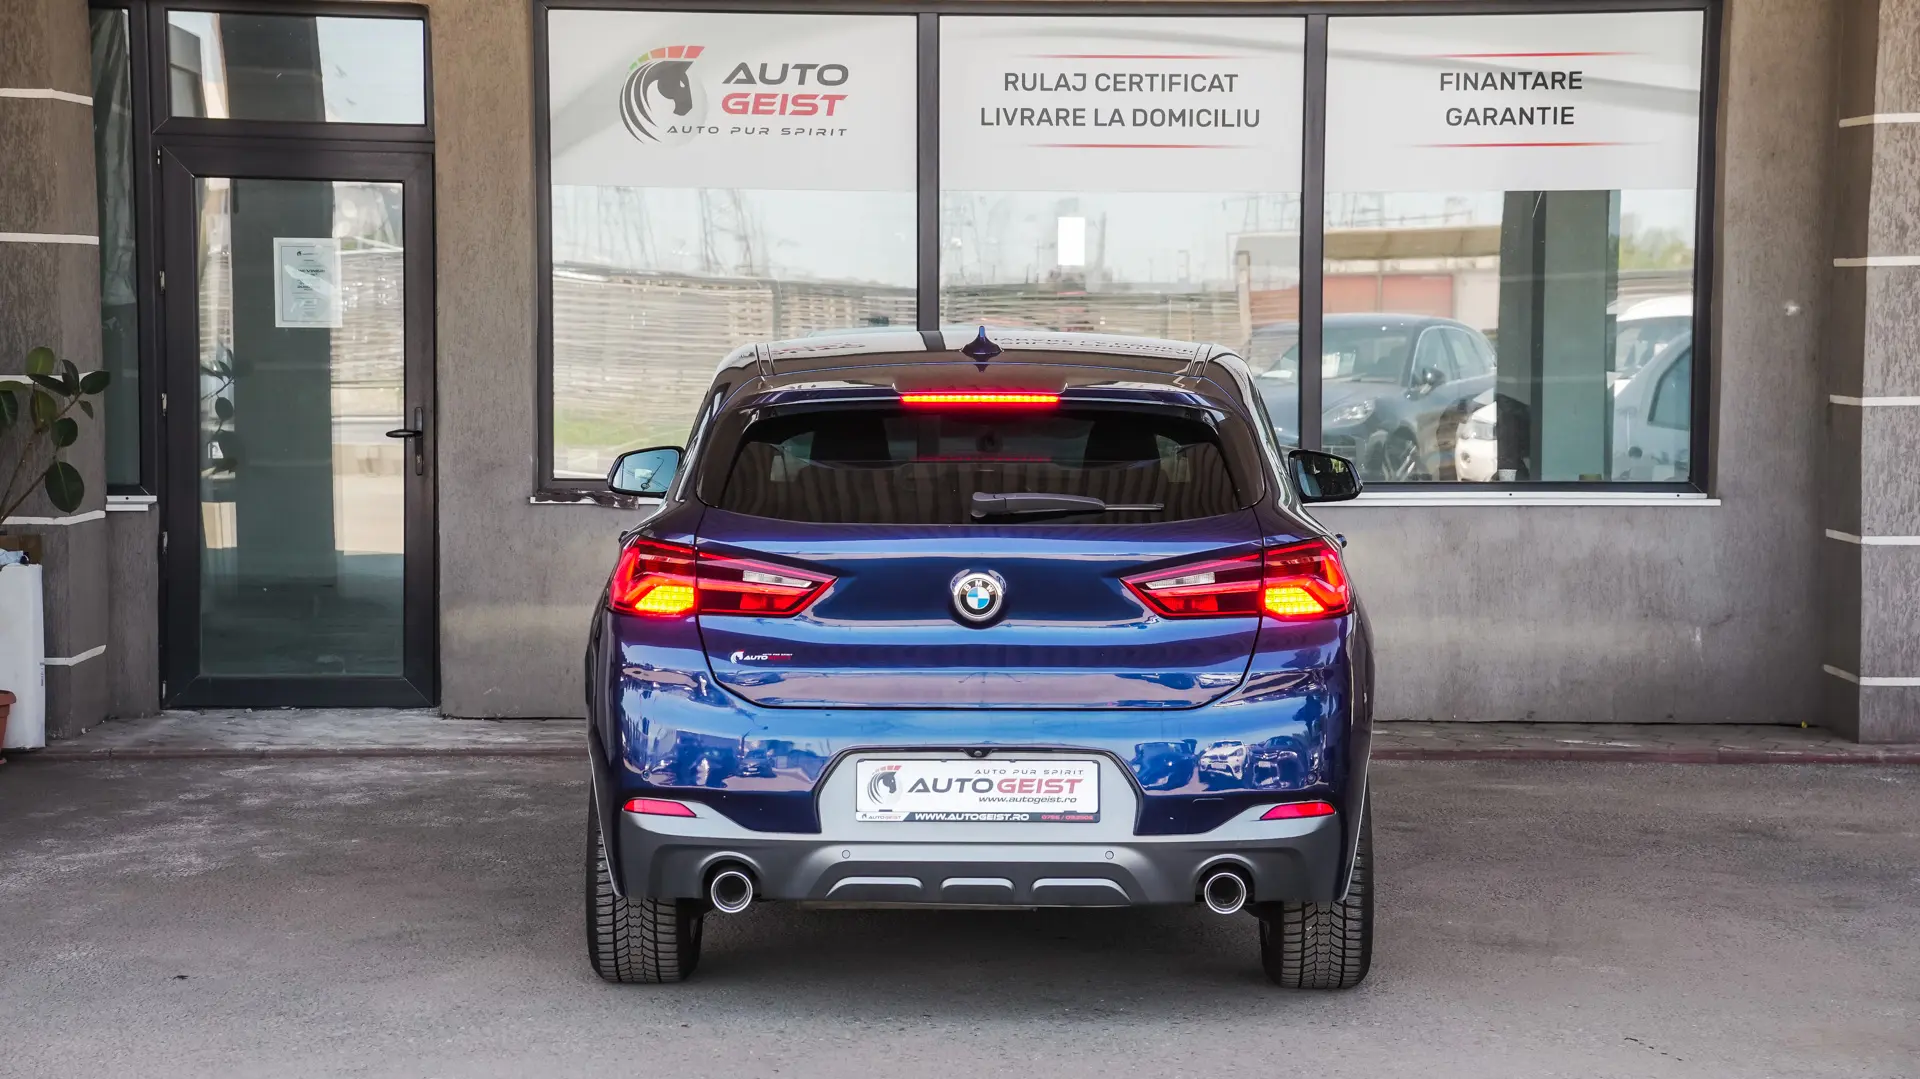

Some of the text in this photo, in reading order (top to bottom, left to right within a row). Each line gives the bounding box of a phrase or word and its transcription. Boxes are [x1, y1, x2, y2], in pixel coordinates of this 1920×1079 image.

[722, 62, 849, 86] AUTO
[1004, 73, 1239, 93] RULAJ CERTIFICAT
[1440, 71, 1583, 91] FINANTARE
[721, 92, 849, 117] GEIST
[980, 107, 1260, 128] LIVRARE LA DOMICILIU
[1445, 106, 1575, 127] GARANTIE
[666, 125, 848, 137] AUTO PUR SPIRIT
[978, 796, 1078, 804] www.autogeist.ro
[914, 813, 1030, 821] WWW.AUTOGEIST.RO
